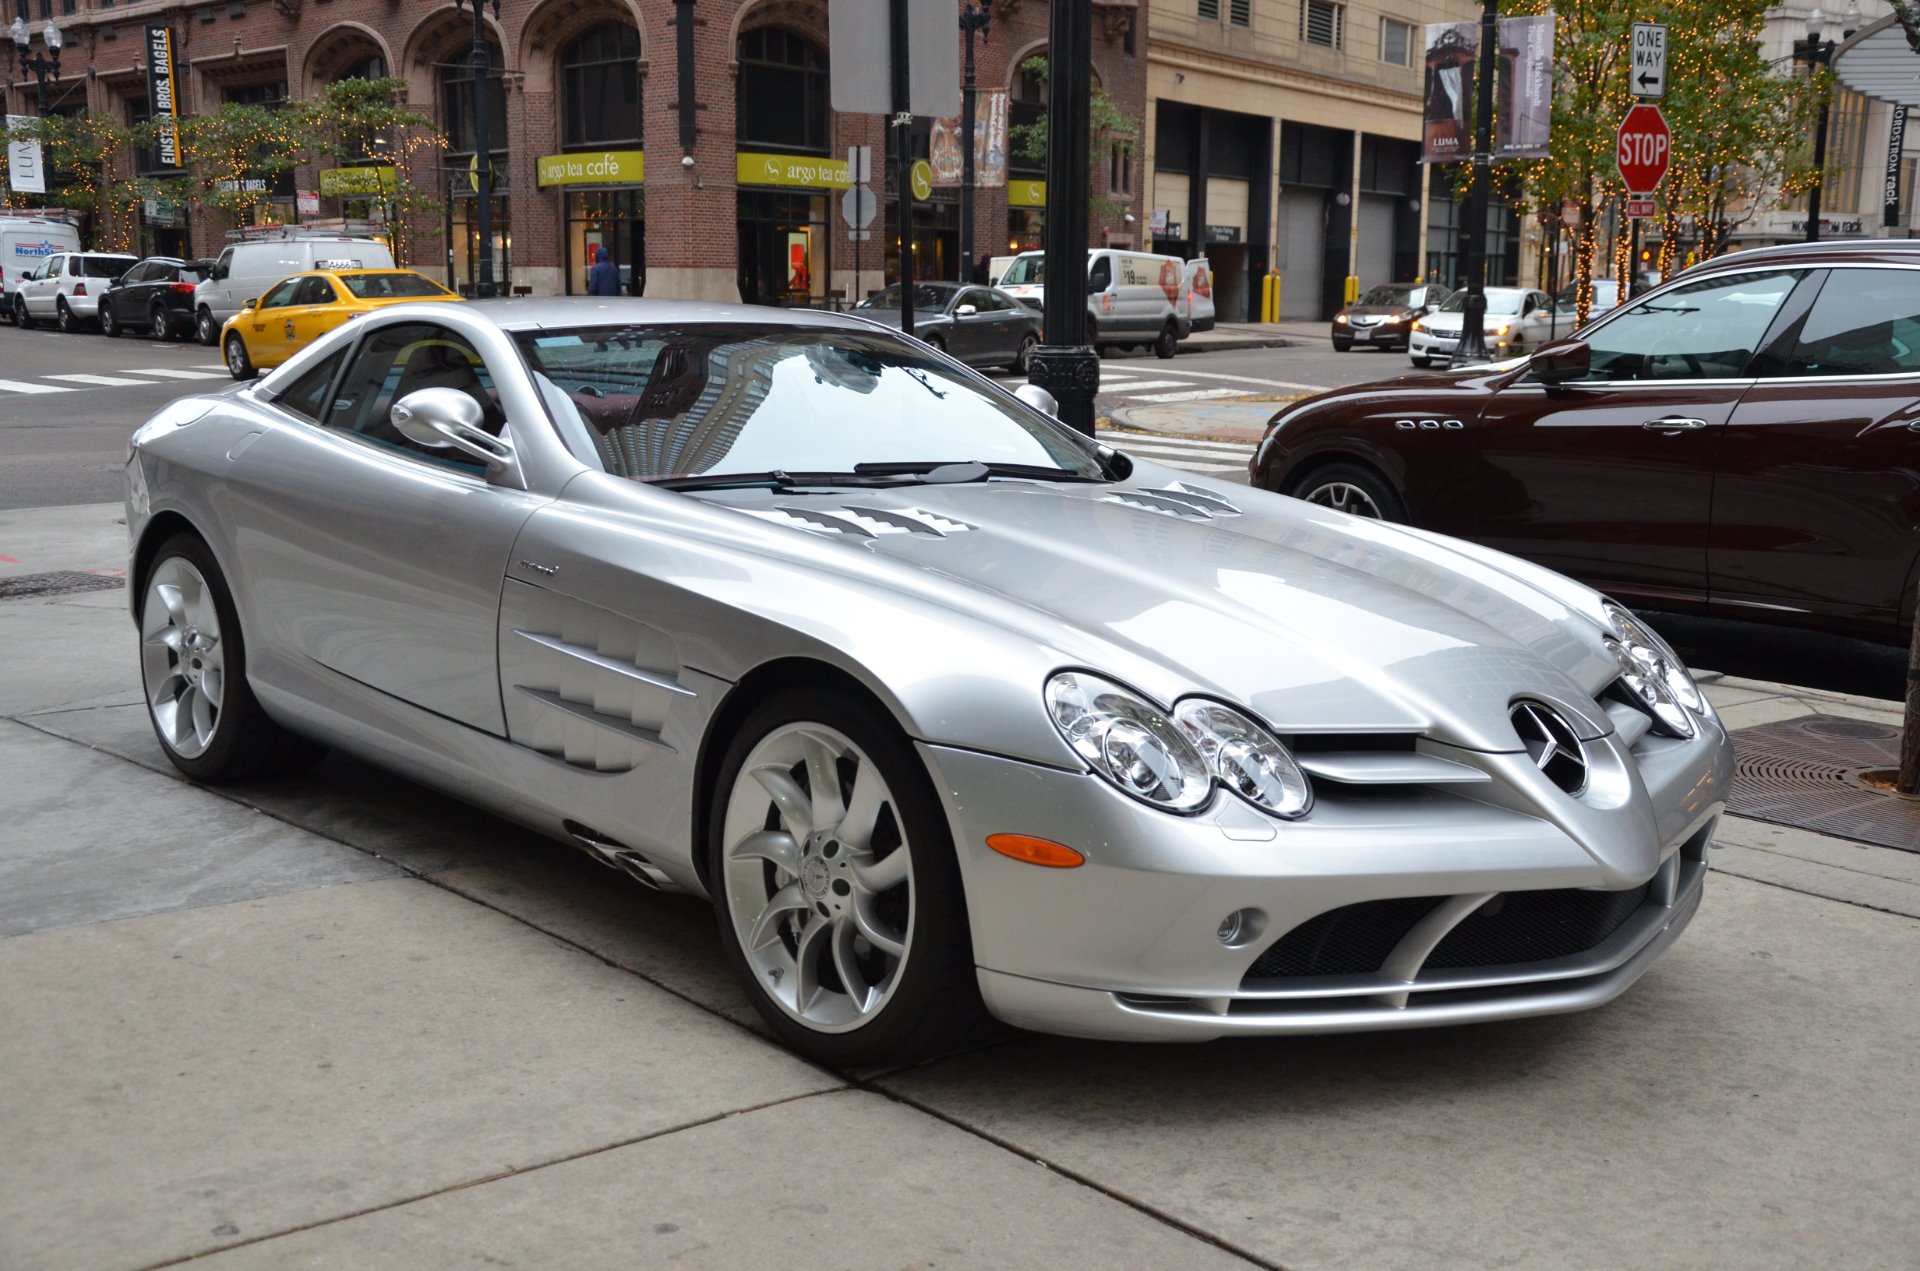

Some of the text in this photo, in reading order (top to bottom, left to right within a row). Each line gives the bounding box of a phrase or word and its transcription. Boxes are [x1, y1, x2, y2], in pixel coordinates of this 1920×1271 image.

[1637, 30, 1662, 48] ONE
[1636, 51, 1662, 67] WAY
[152, 29, 176, 164] EINSTN BROS. BAGELS
[1433, 137, 1459, 146] LUMA
[1620, 133, 1667, 166] STOP
[18, 141, 34, 178] LUM
[548, 153, 619, 182] argo tea café
[787, 164, 816, 184] argo
[818, 164, 833, 181] tea
[245, 179, 266, 191] BAGELS
[1885, 175, 1898, 205] rack
[1629, 203, 1655, 215] ALL WAY
[1842, 217, 1864, 233] rack
